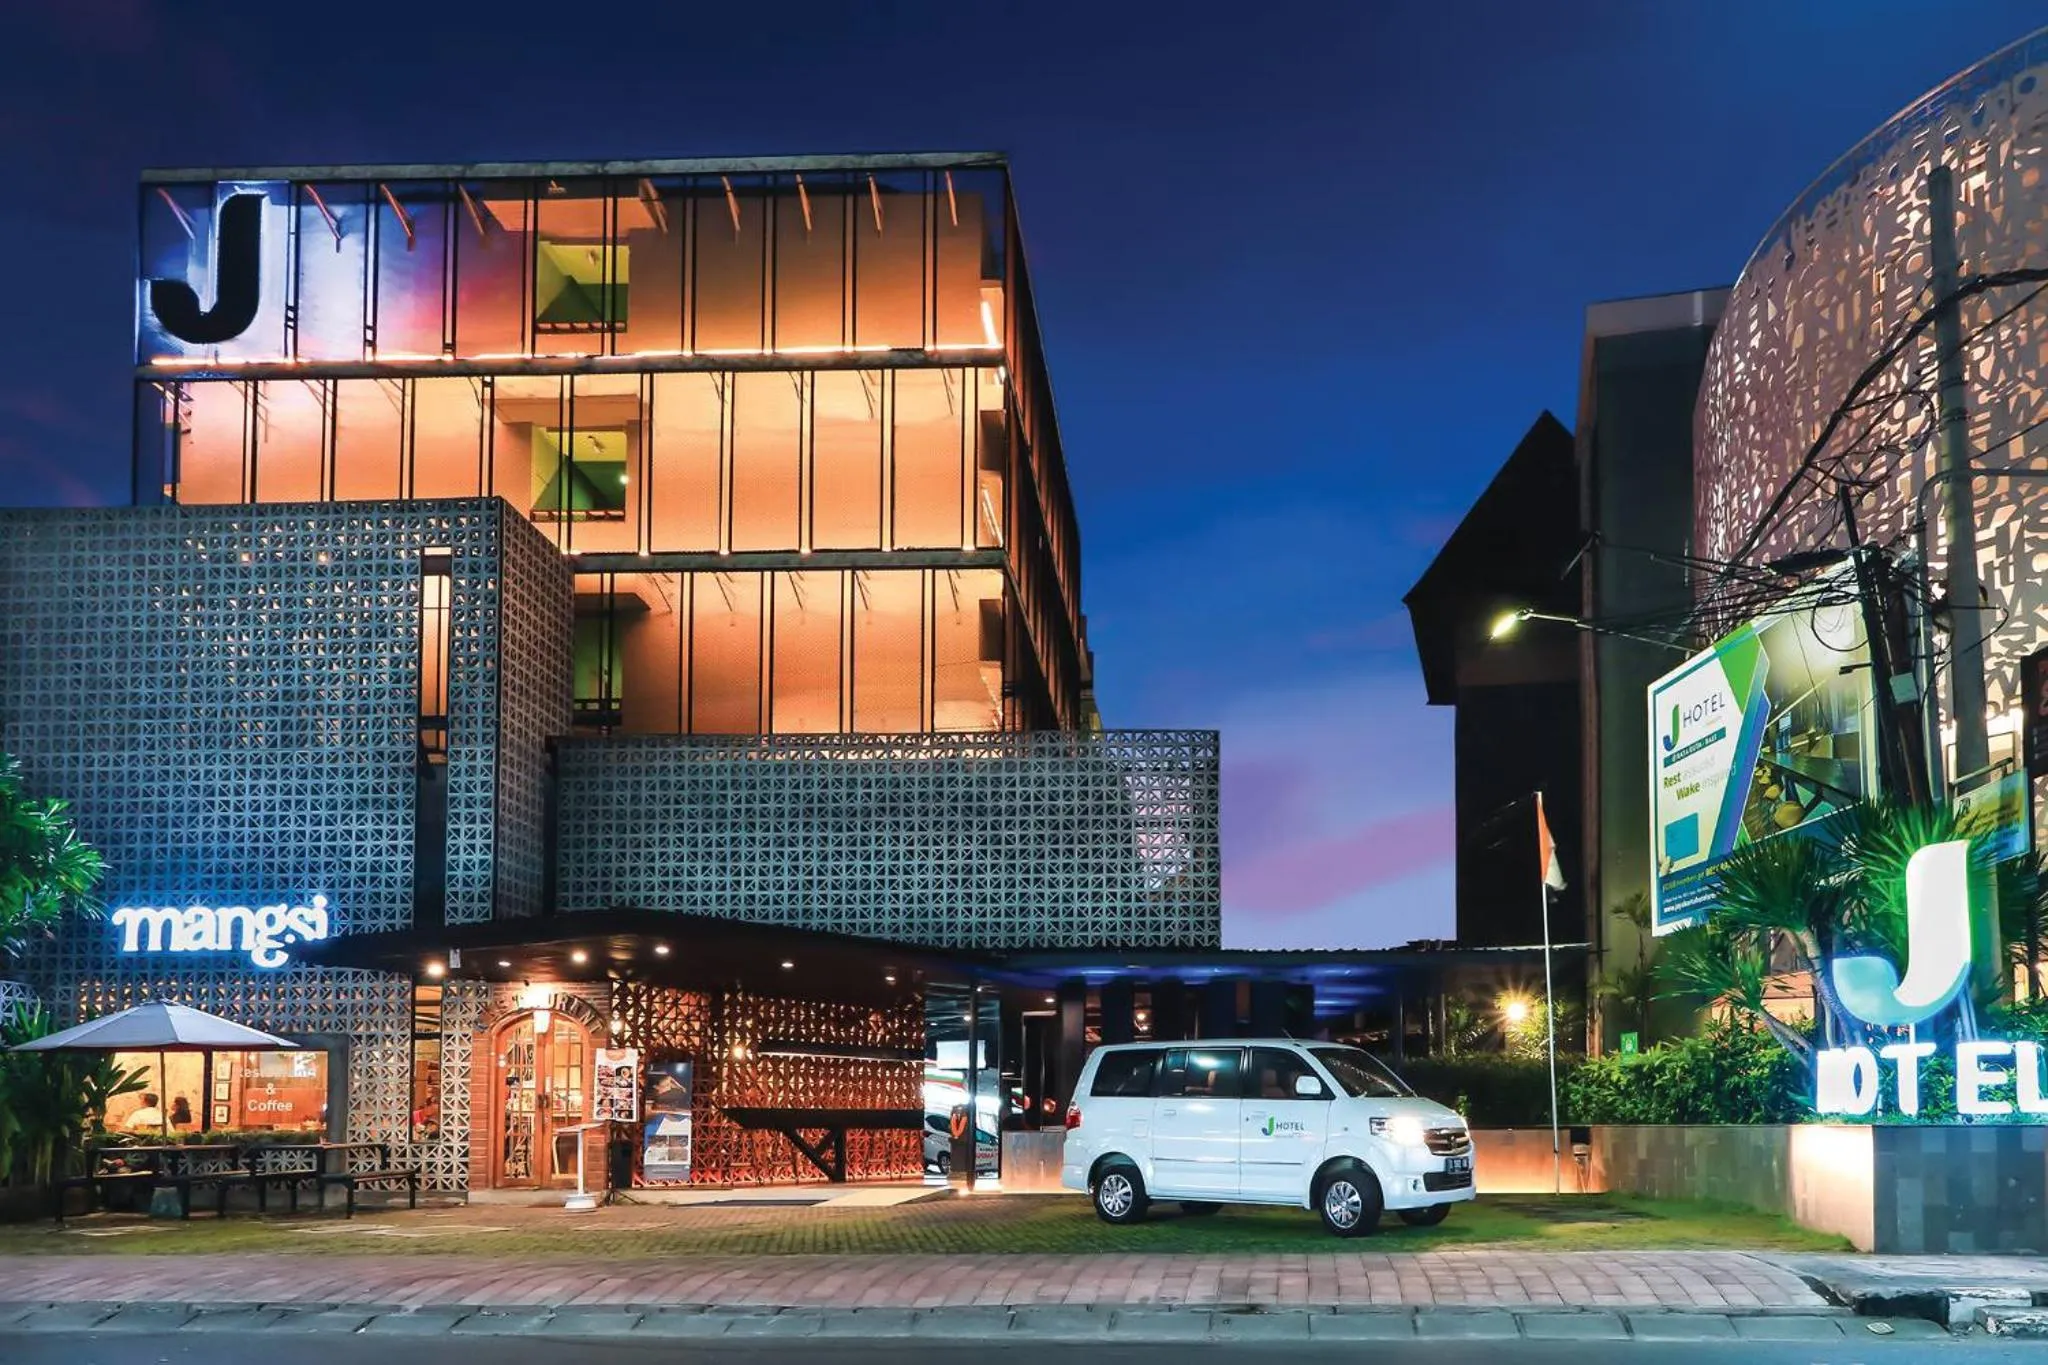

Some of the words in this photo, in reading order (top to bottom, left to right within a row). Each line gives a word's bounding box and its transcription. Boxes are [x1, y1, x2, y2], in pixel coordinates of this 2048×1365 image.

[150, 193, 263, 344] J
[1663, 704, 1680, 752] J
[1683, 692, 1726, 728] HOTEL
[1663, 772, 1682, 790] Rest
[1676, 782, 1701, 801] Wake
[111, 895, 328, 968] mangsi
[1833, 839, 1972, 1026] J
[265, 1083, 276, 1096] &
[247, 1099, 293, 1112] Coffee
[1261, 1116, 1275, 1137] J
[1276, 1122, 1305, 1131] HOTEL
